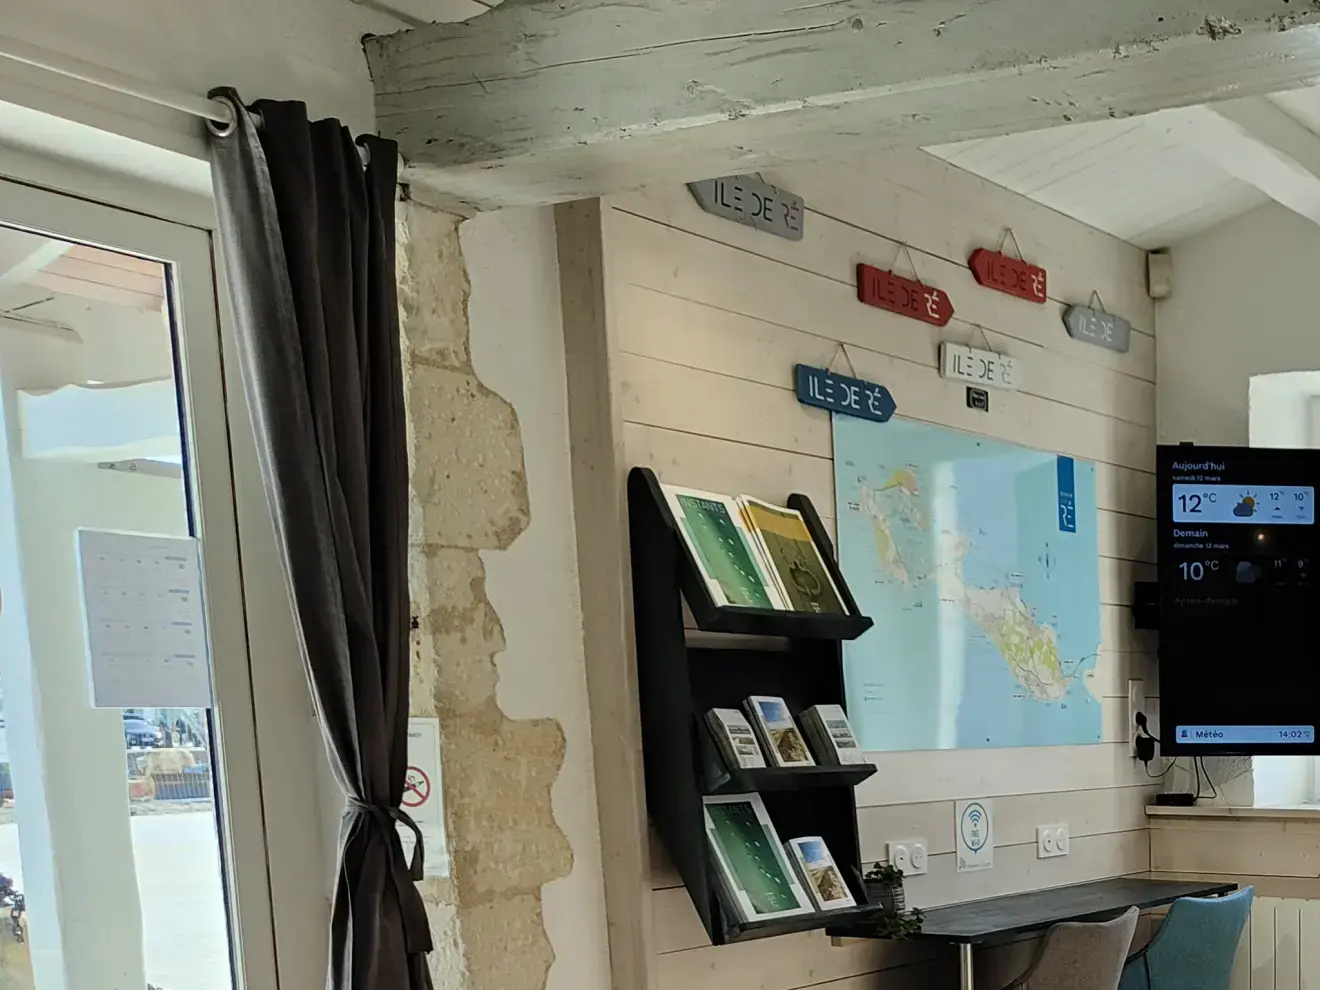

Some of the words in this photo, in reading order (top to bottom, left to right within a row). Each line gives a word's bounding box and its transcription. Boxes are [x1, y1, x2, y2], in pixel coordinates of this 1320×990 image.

[715, 180, 743, 212] ILE
[751, 192, 773, 222] DE
[781, 201, 799, 231] RÉ
[987, 260, 1006, 285] ILE
[1012, 268, 1026, 291] DE
[1030, 272, 1044, 297] RÉ
[873, 277, 895, 304] ILE
[901, 284, 918, 311] DE
[924, 291, 940, 319] RÉ
[1079, 314, 1097, 337] ILE
[1101, 320, 1113, 342] DE
[953, 354, 974, 377] ILE
[978, 359, 995, 381] DE
[1000, 360, 1013, 384] RÉ
[808, 375, 835, 402] ILE
[840, 383, 860, 409] DE
[865, 387, 882, 415] RÉ
[1172, 461, 1225, 471] Aujourd'hui
[1060, 501, 1074, 528] RÉ
[1173, 529, 1208, 538] Demain
[1196, 730, 1223, 738] Météo
[1279, 730, 1302, 738] 14:02
